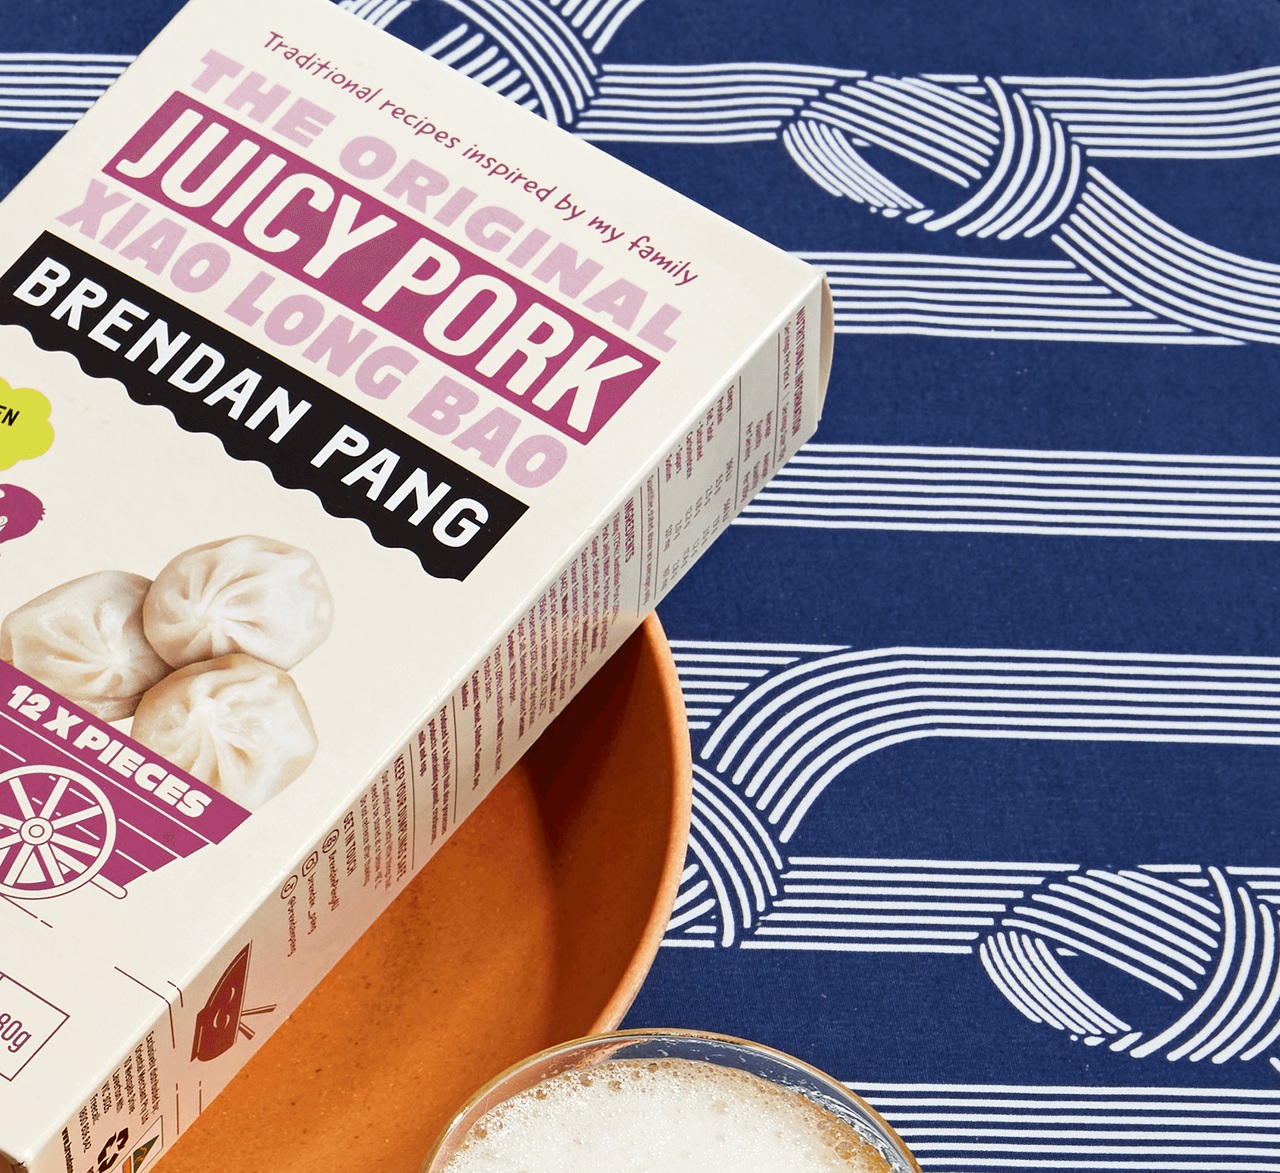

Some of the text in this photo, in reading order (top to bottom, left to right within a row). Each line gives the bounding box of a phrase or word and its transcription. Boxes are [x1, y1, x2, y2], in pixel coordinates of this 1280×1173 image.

[190, 48, 682, 353] THE ORIGINAL
[264, 31, 699, 287] Traditional recipes inspired by my family
[115, 108, 643, 433] JUICY PORK
[54, 178, 568, 489] XIAO LONG BAO
[791, 305, 806, 437] NUTRITIONAL INFORMATION
[12, 256, 489, 548] BRENDAN PANG
[624, 496, 635, 564] INGREDIENTS
[7, 685, 213, 818] 12 X PIECES
[345, 840, 357, 877] TOUCH
[393, 753, 408, 883] KEEP YOUR DUMPLINGS SAFE
[112, 1067, 122, 1102] Laverton
[124, 1064, 134, 1098] Westgate
[134, 1043, 144, 1074] Oriental
[138, 1069, 147, 1104] Merchant
[145, 1030, 157, 1071] Exclusively
[149, 1067, 160, 1105] distributed
